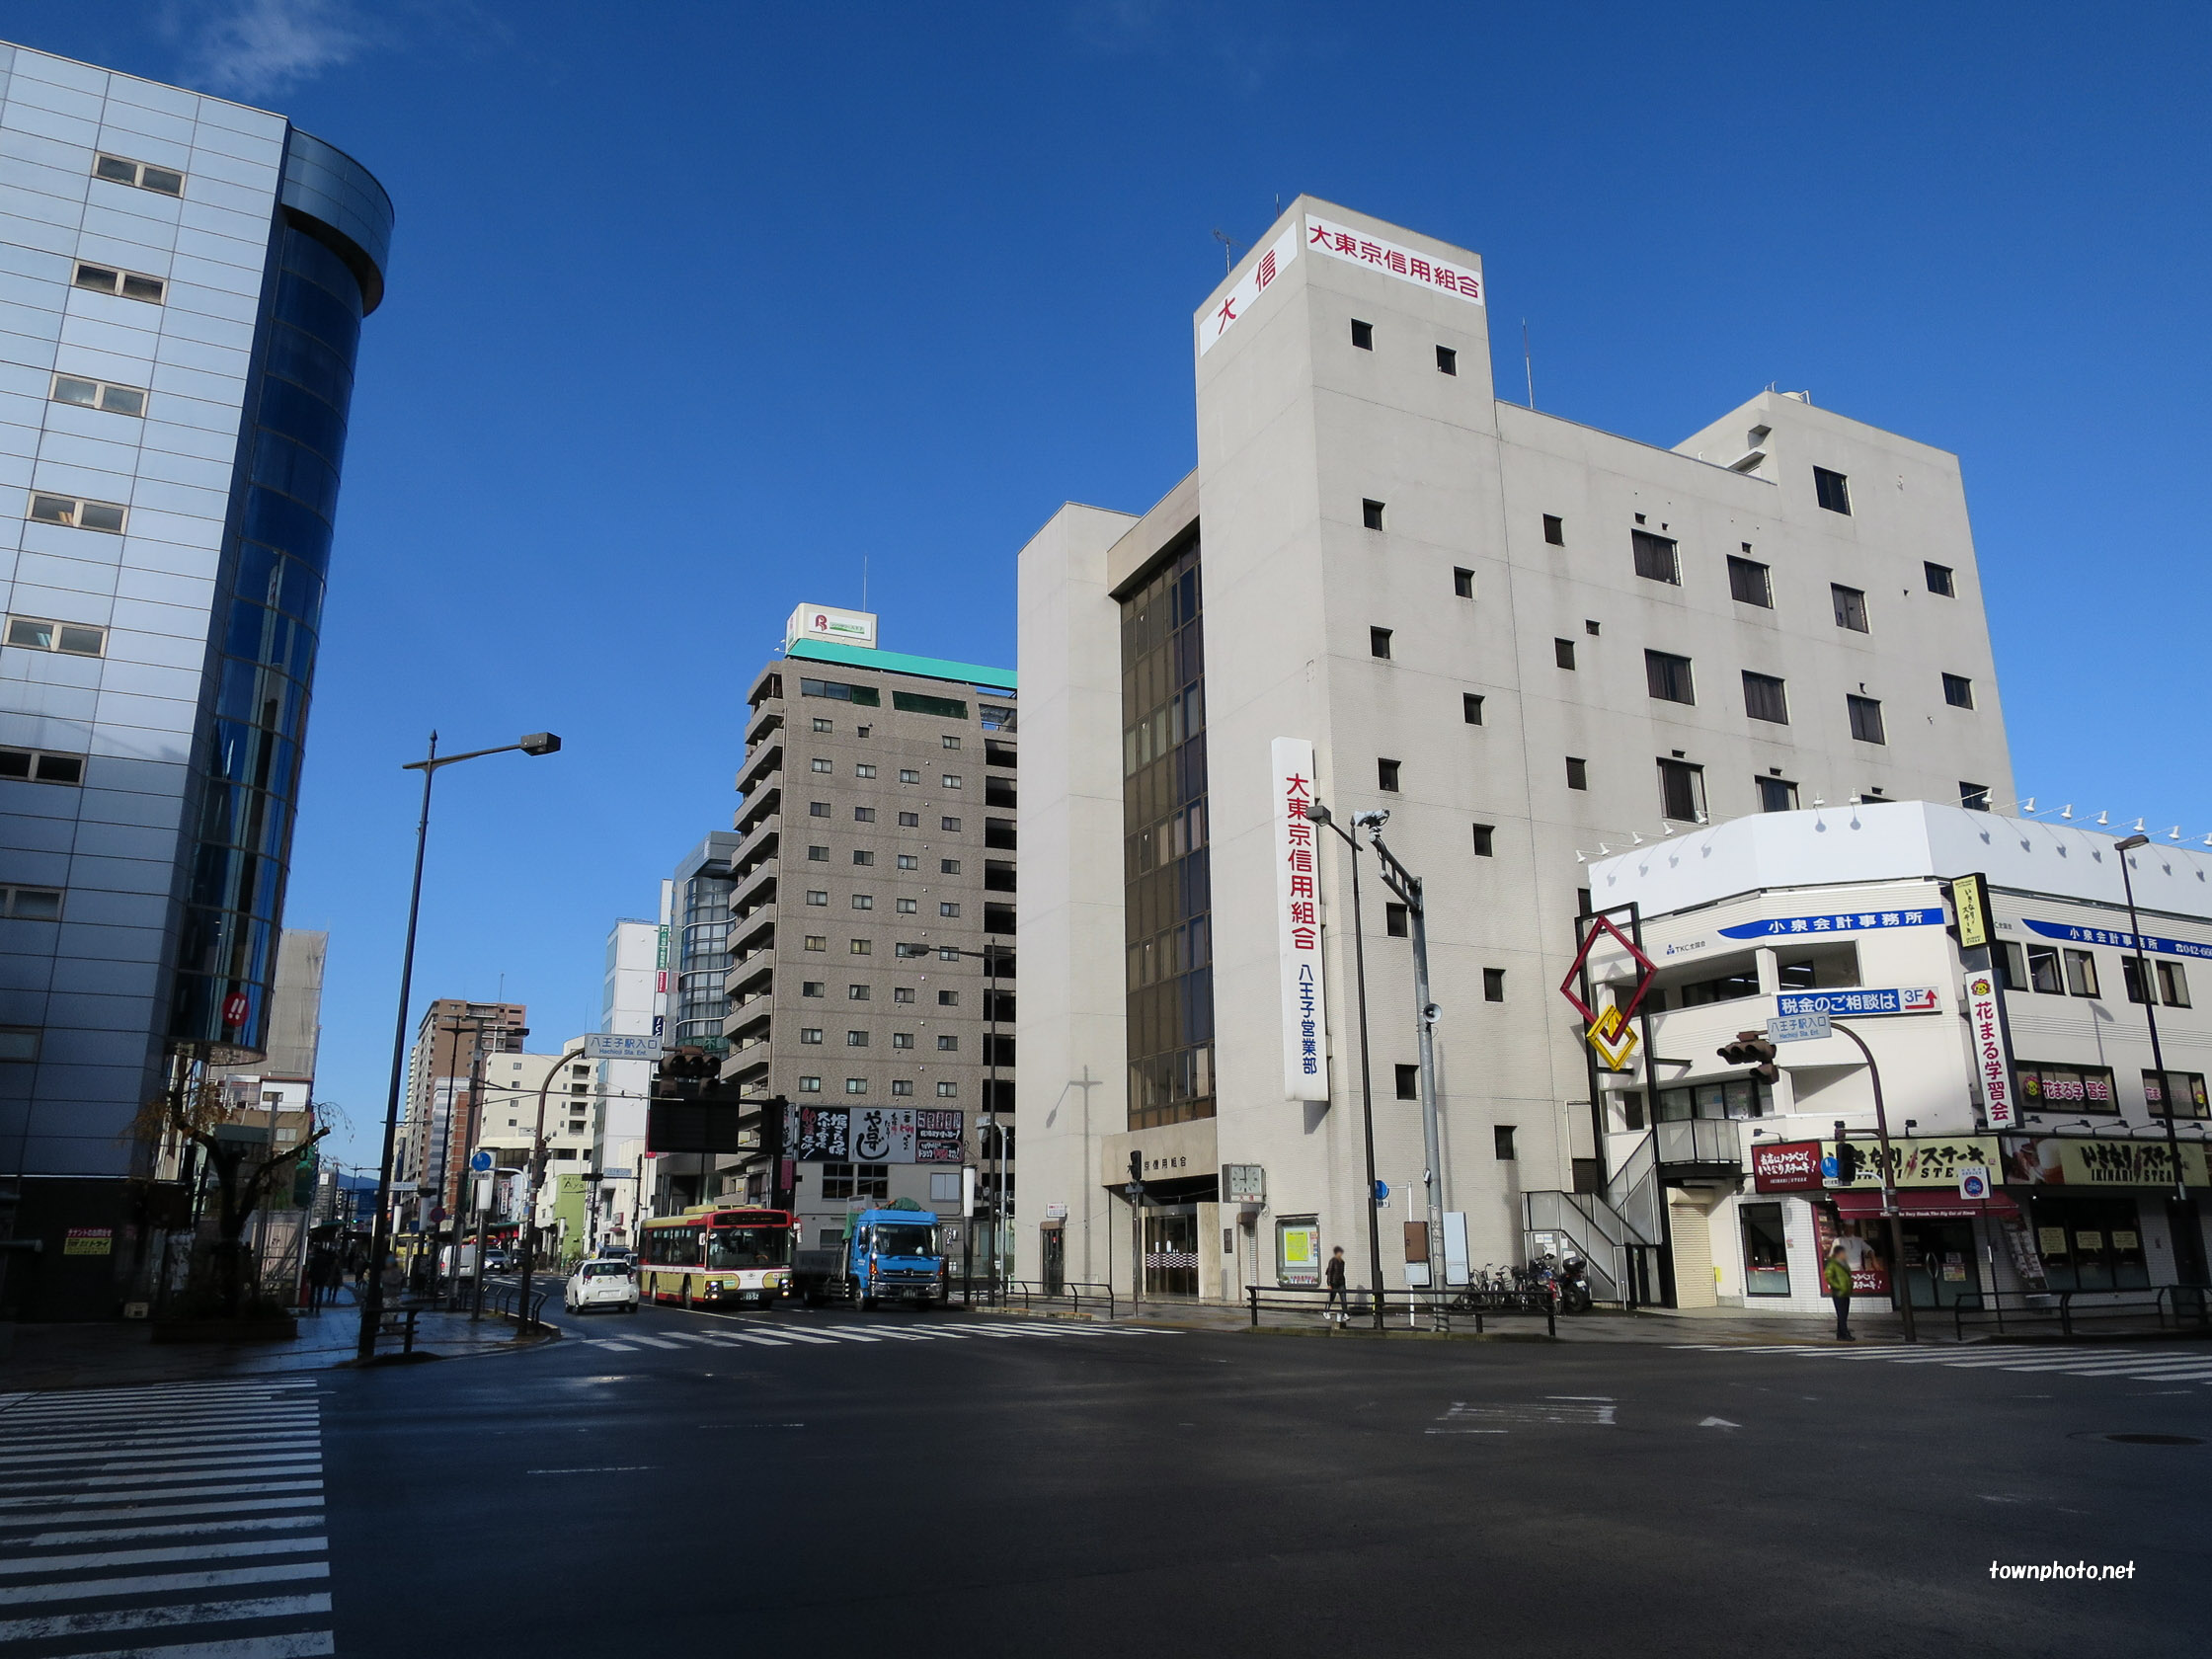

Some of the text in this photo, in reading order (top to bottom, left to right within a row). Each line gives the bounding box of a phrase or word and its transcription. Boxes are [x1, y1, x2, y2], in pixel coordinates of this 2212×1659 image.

[1308, 225, 1479, 298] 大東京信用組合
[1218, 249, 1277, 335] 大信
[1286, 773, 1316, 951] 大東京信用組合
[1768, 910, 1924, 934] 小泉会計事務所
[1781, 989, 1924, 1014] 税金のご相談は 3F
[1299, 964, 1317, 1075] 八王子営業部
[1771, 1016, 1827, 1033] 八王子駅入口
[591, 1037, 658, 1050] 八王子駅入口
[1975, 1000, 2009, 1122] 花まる学習会
[2041, 1079, 2109, 1101] 花まる学習会
[1128, 1156, 1187, 1172] 大京信用組合
[1920, 1145, 1985, 1166] ステーキ
[2080, 1143, 2133, 1169] いきなり
[2092, 1169, 2176, 1182] IKINARI STEA
